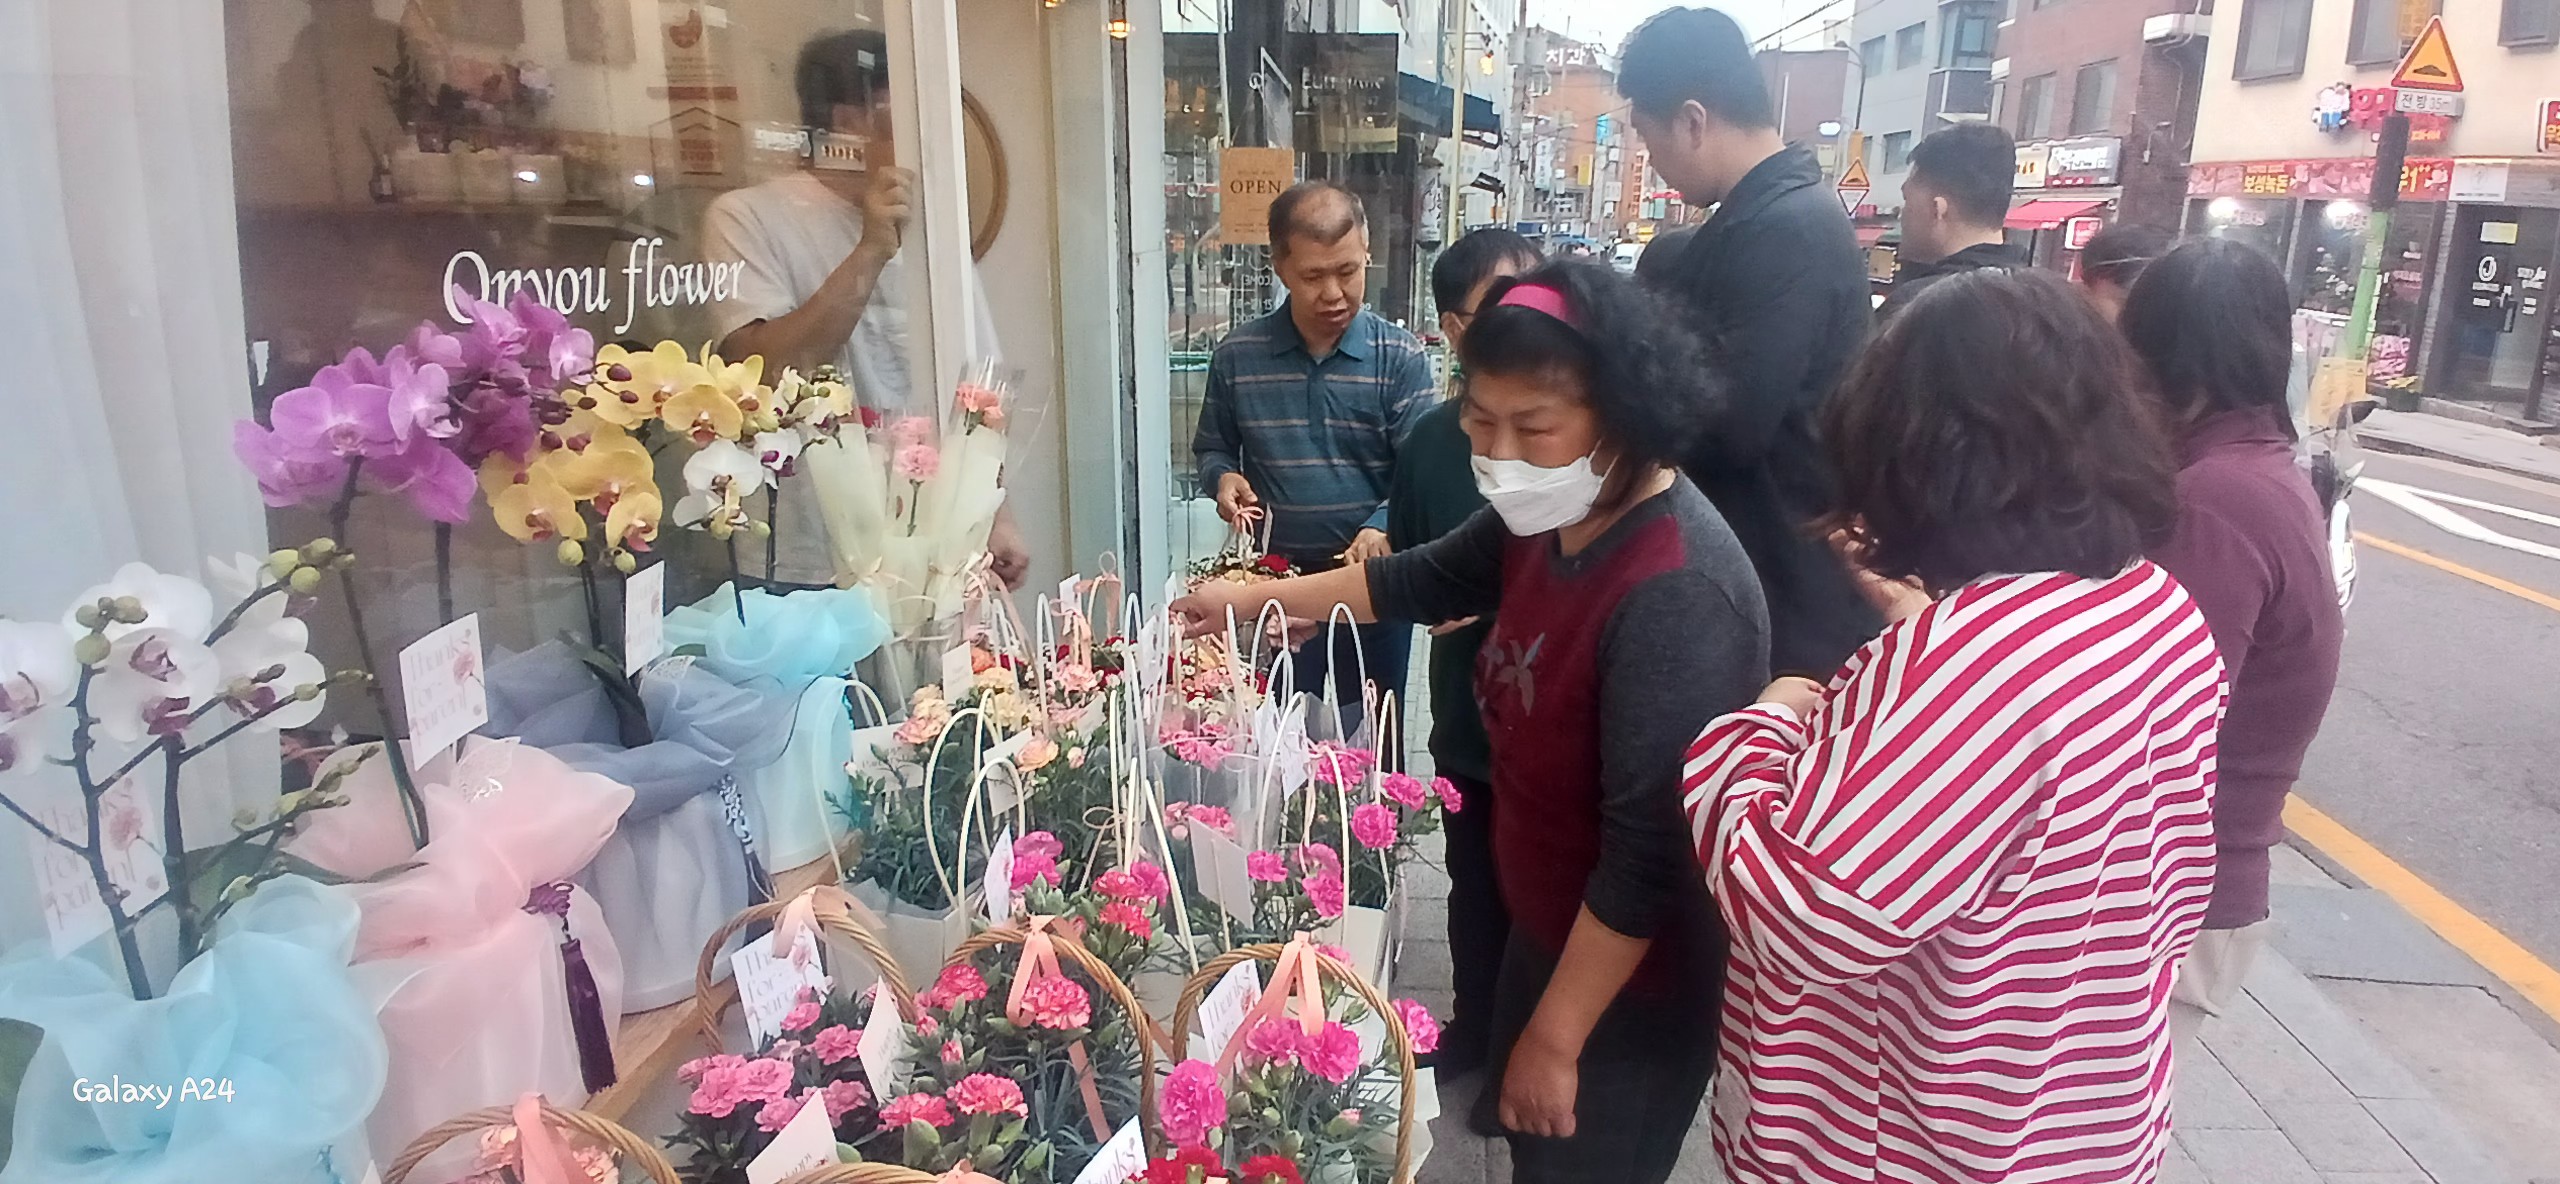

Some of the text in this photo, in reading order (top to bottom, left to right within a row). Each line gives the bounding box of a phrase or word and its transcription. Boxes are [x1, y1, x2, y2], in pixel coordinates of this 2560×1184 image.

[1545, 47, 1587, 67] 치과
[1230, 179, 1282, 195] OPEN
[615, 237, 746, 335] flower
